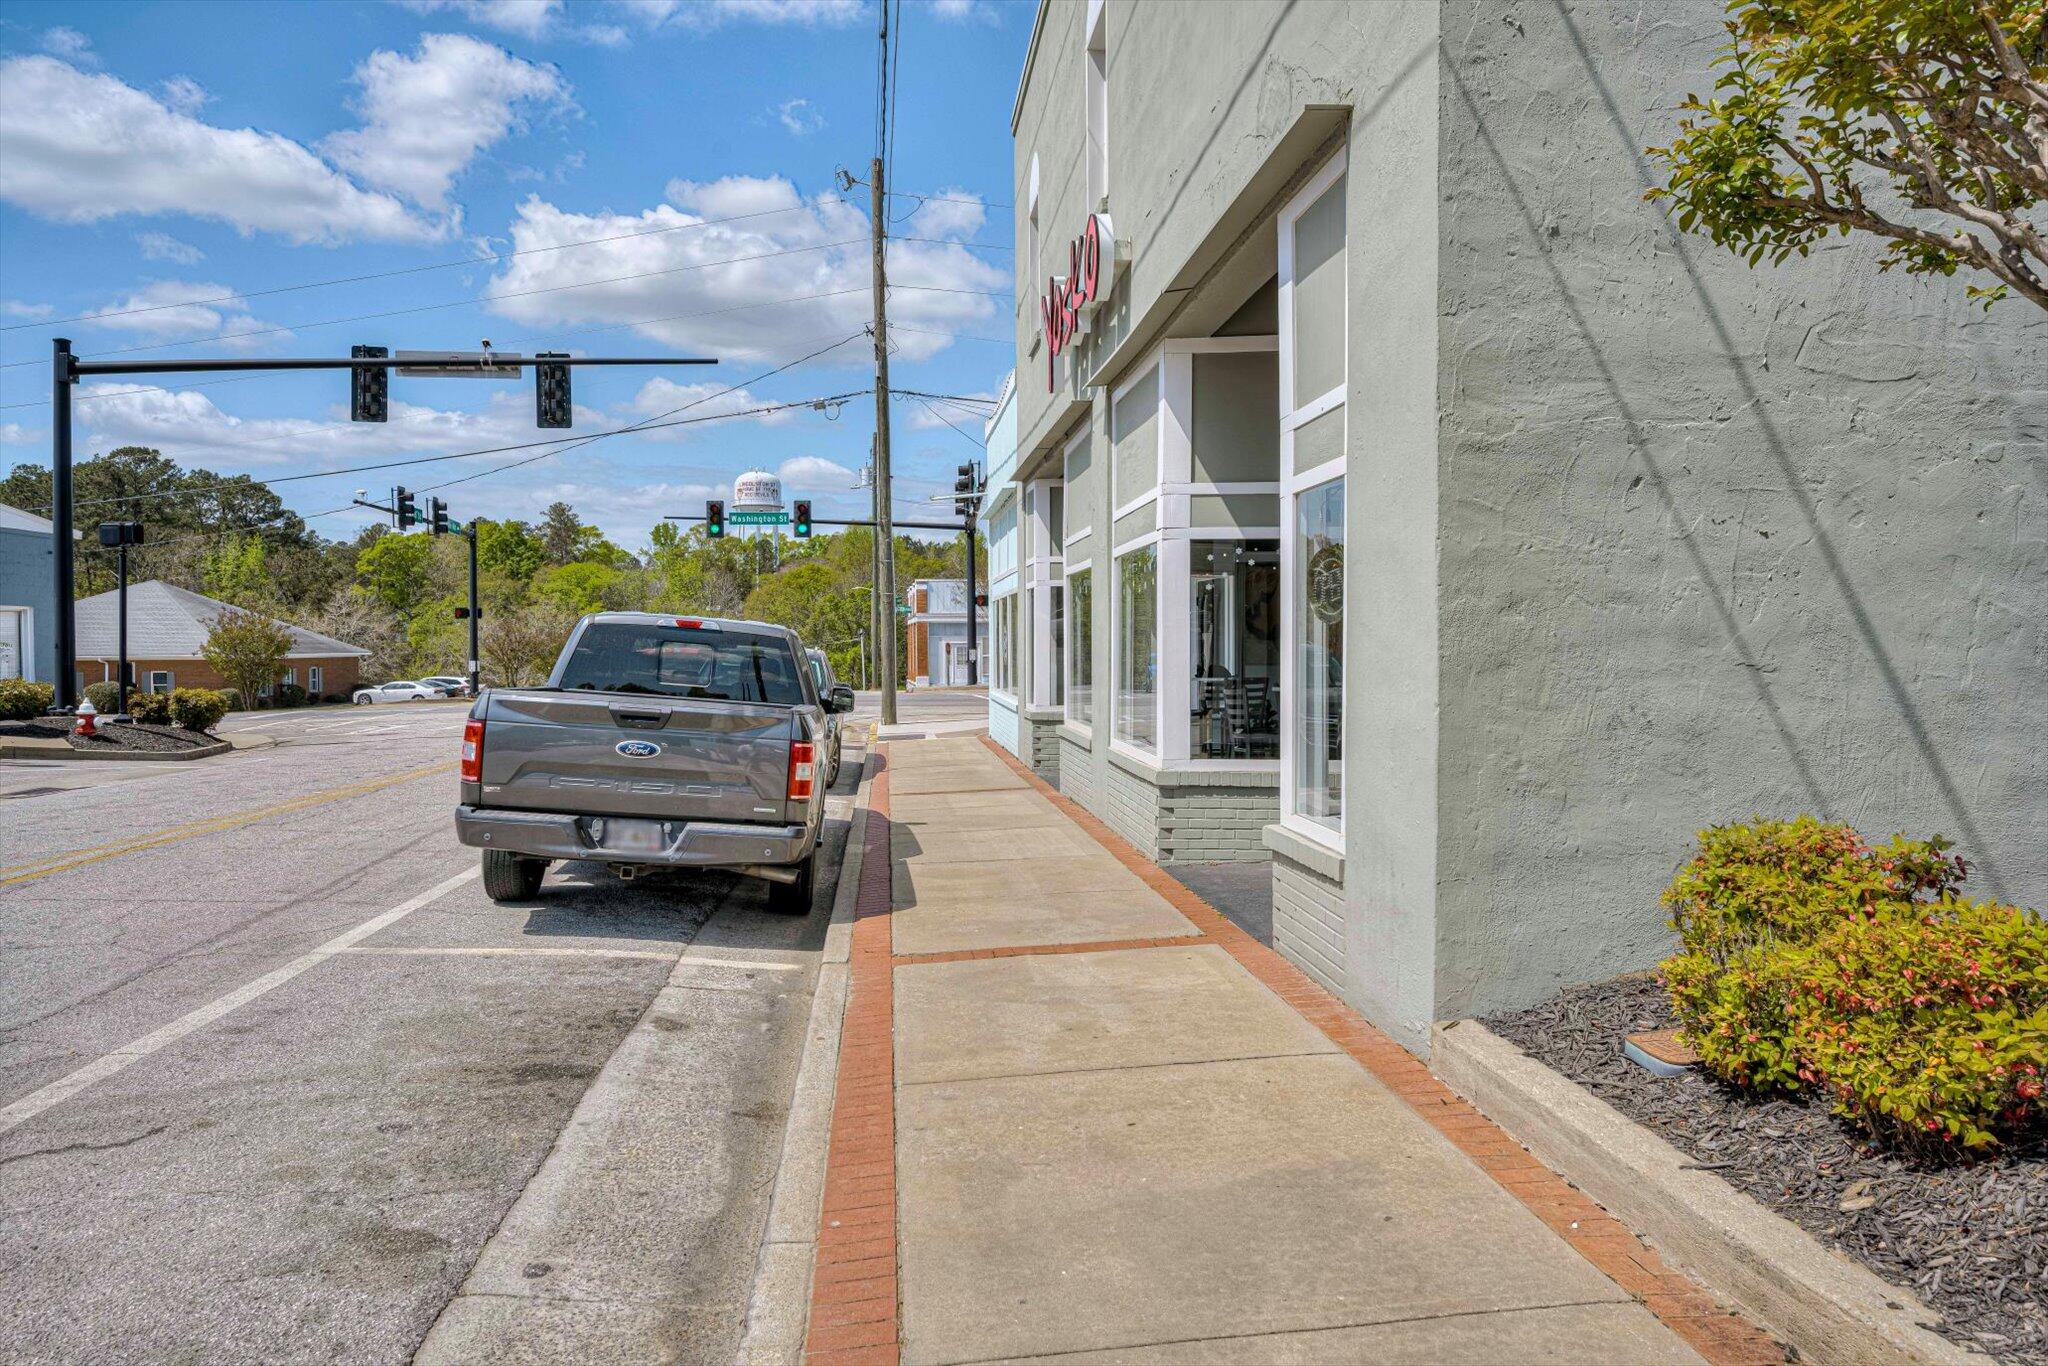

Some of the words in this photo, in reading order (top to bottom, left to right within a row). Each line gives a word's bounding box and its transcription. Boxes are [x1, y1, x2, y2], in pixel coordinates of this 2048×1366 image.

[731, 515, 777, 523] Washington
[779, 515, 787, 523] St
[624, 742, 650, 757] Ford
